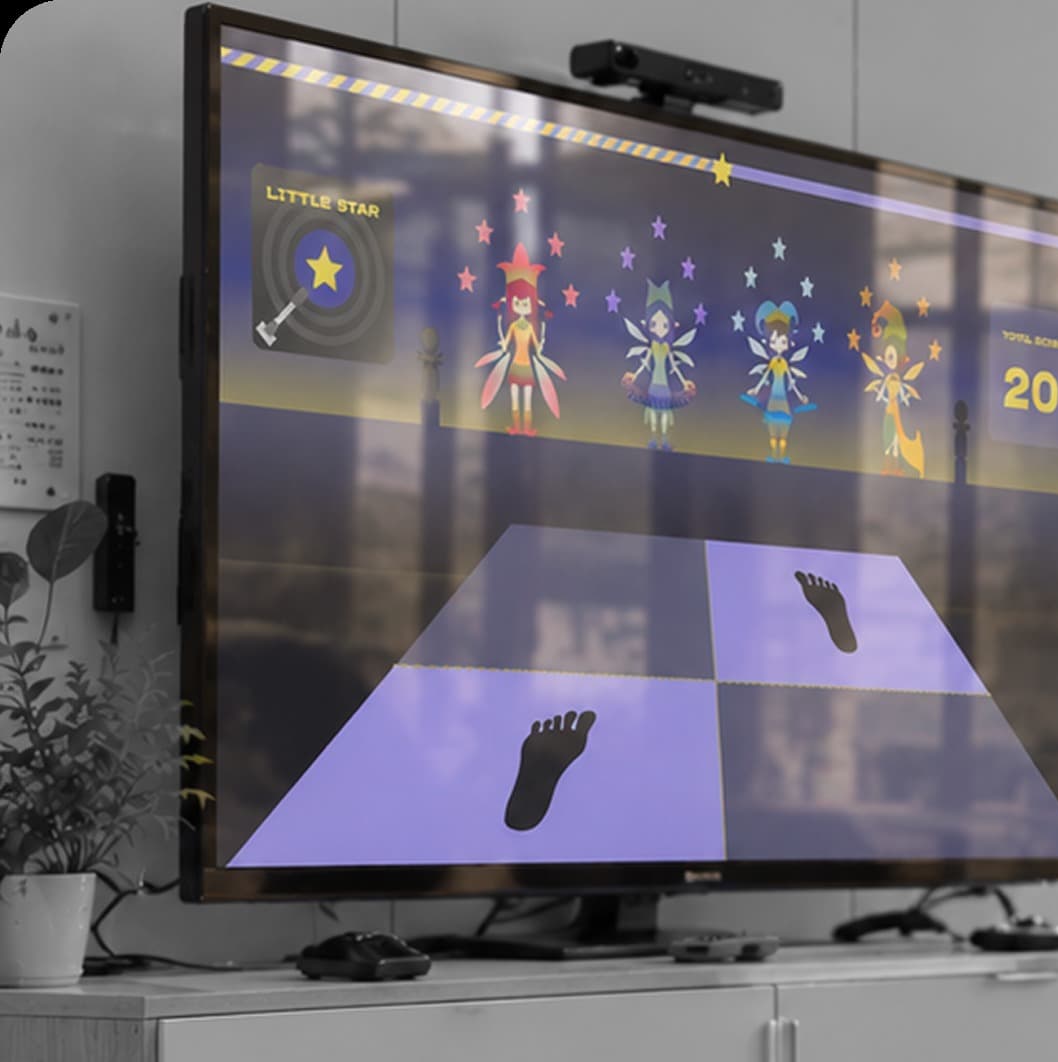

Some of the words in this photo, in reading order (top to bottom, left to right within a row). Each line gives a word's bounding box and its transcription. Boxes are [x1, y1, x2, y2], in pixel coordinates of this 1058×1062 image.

[266, 186, 331, 210] LITTLE
[337, 199, 380, 219] STAR
[1003, 366, 1058, 414] 20
